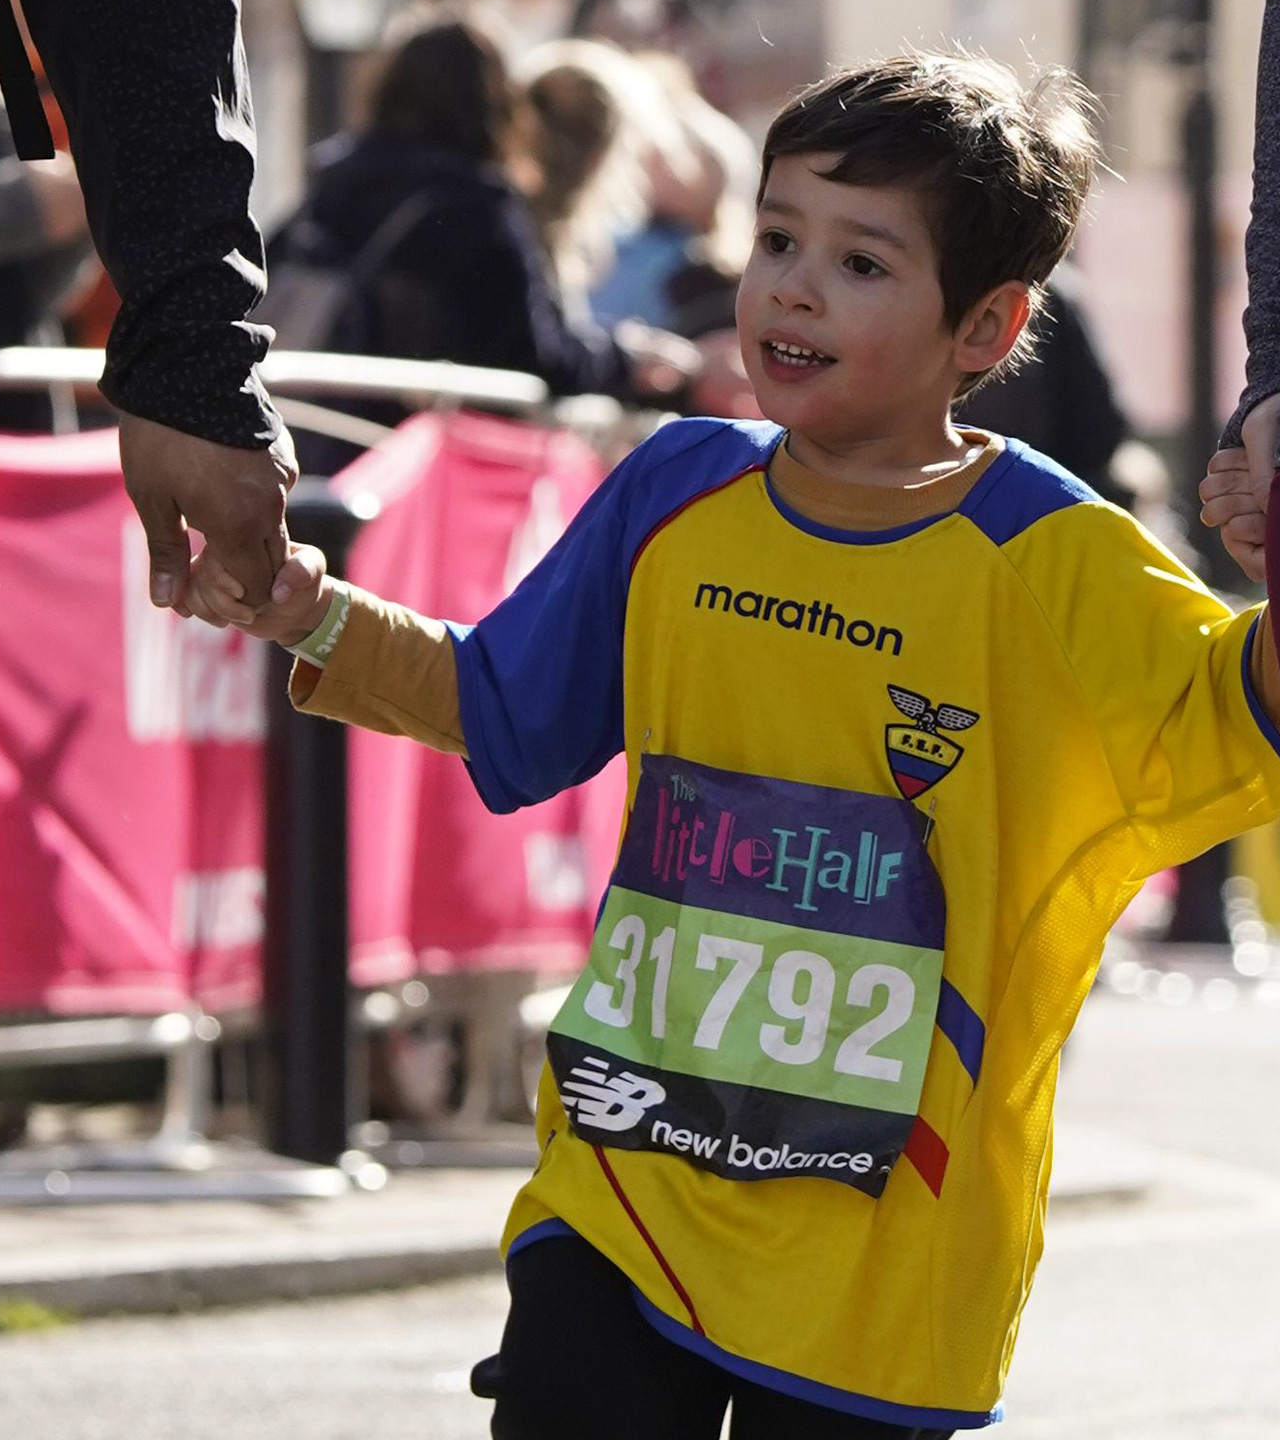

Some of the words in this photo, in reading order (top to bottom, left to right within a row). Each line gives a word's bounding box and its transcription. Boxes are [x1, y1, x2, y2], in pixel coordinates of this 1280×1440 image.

[694, 582, 904, 656] marathon
[670, 773, 697, 803] The
[652, 788, 774, 884] little
[583, 914, 916, 1082] 31792
[651, 1116, 721, 1161] new
[727, 1133, 874, 1175] balance
